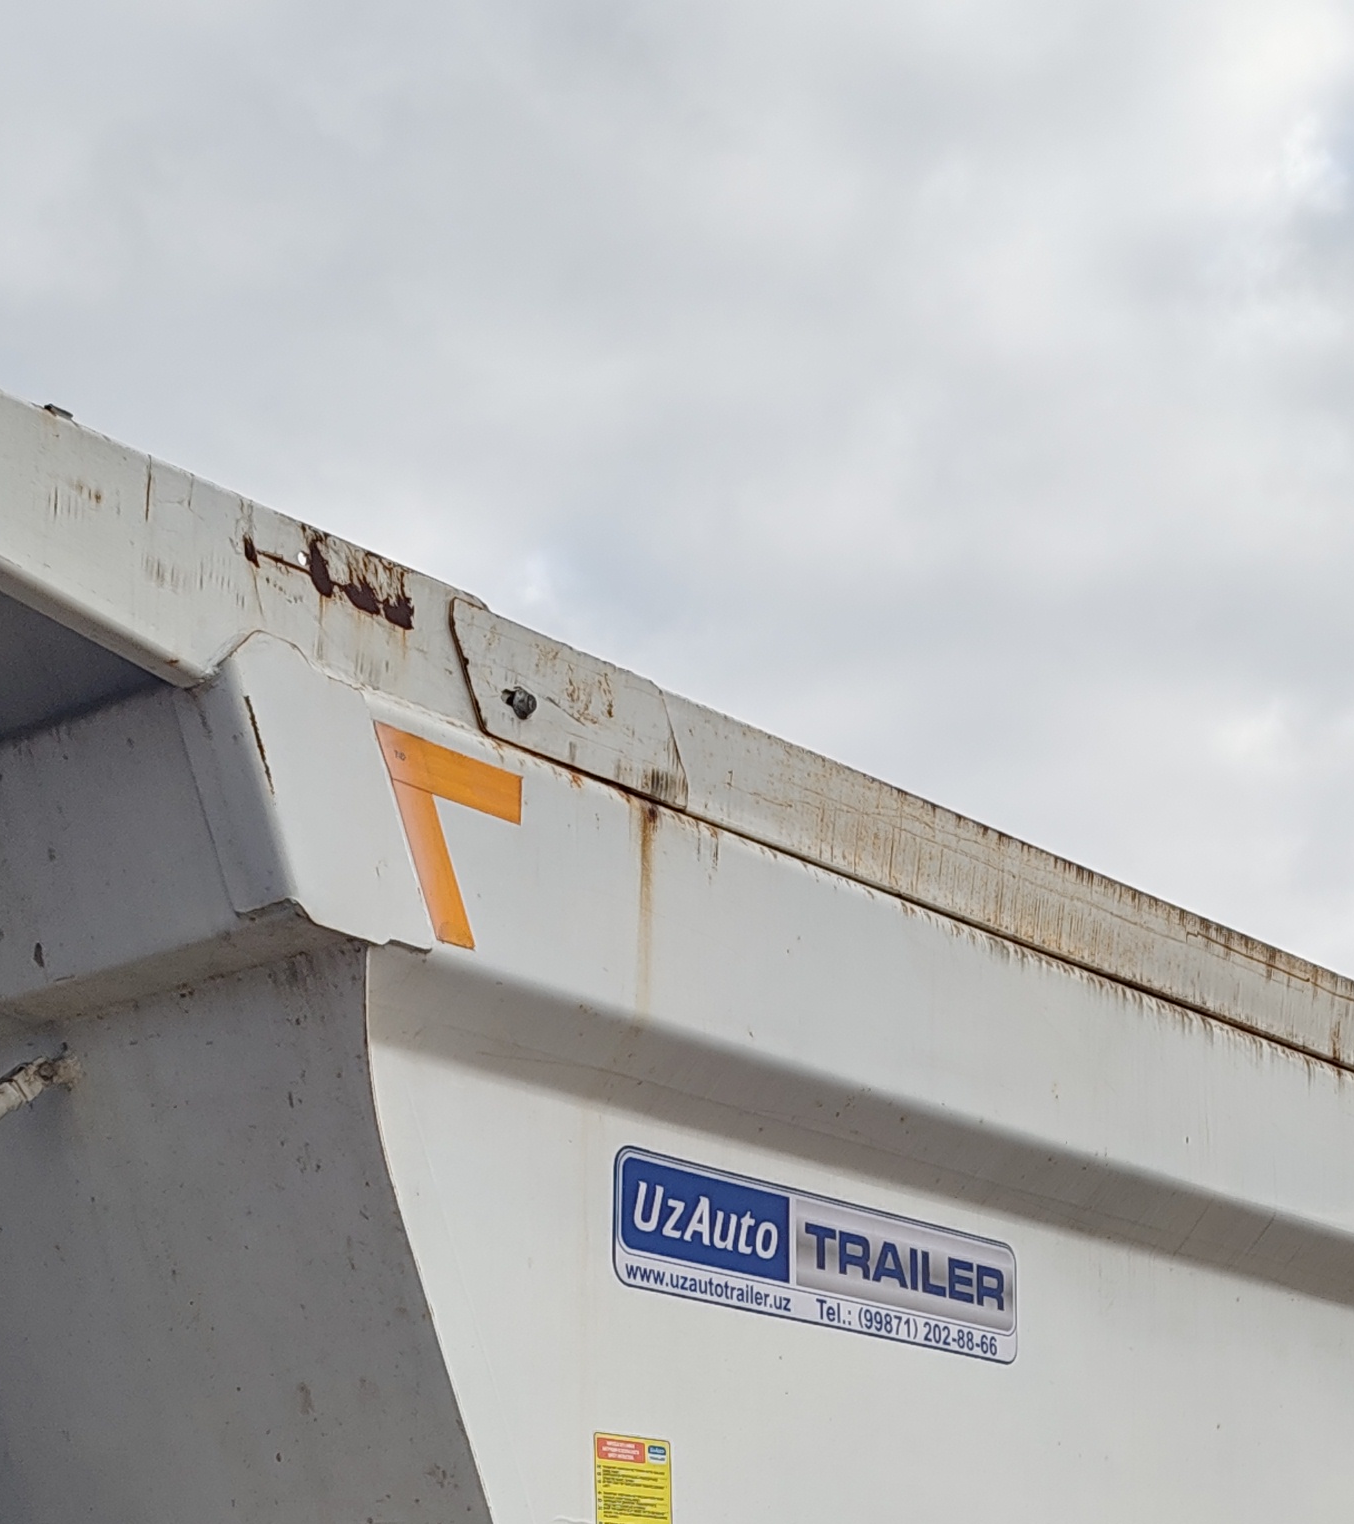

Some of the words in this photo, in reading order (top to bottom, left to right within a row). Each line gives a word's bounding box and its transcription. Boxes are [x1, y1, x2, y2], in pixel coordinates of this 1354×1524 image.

[632, 1180, 778, 1260] UzAuto
[625, 1263, 791, 1312] www.uzautotrailer.uz
[805, 1221, 1005, 1311] TRAILER
[816, 1298, 852, 1327] Tel.:
[858, 1307, 918, 1340] (99871)
[923, 1326, 998, 1357] 202-88-66
